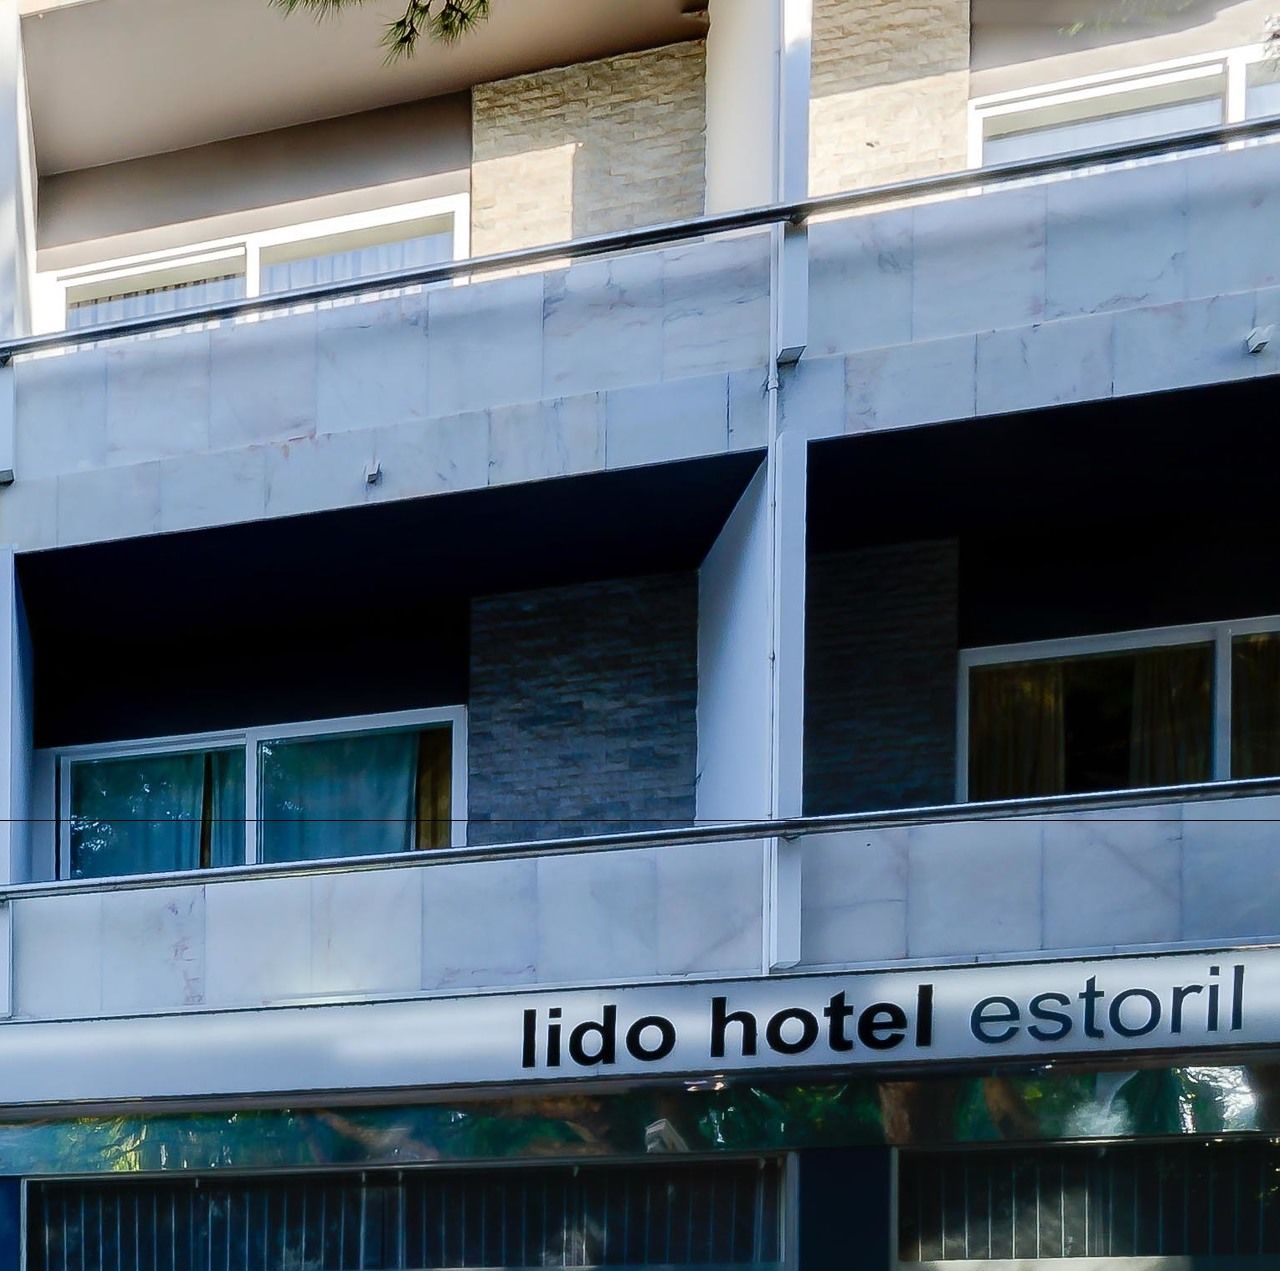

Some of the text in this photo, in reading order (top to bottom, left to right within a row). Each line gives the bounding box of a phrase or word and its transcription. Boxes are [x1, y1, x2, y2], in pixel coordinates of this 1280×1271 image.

[521, 964, 1245, 1069] lido hotel estoril
